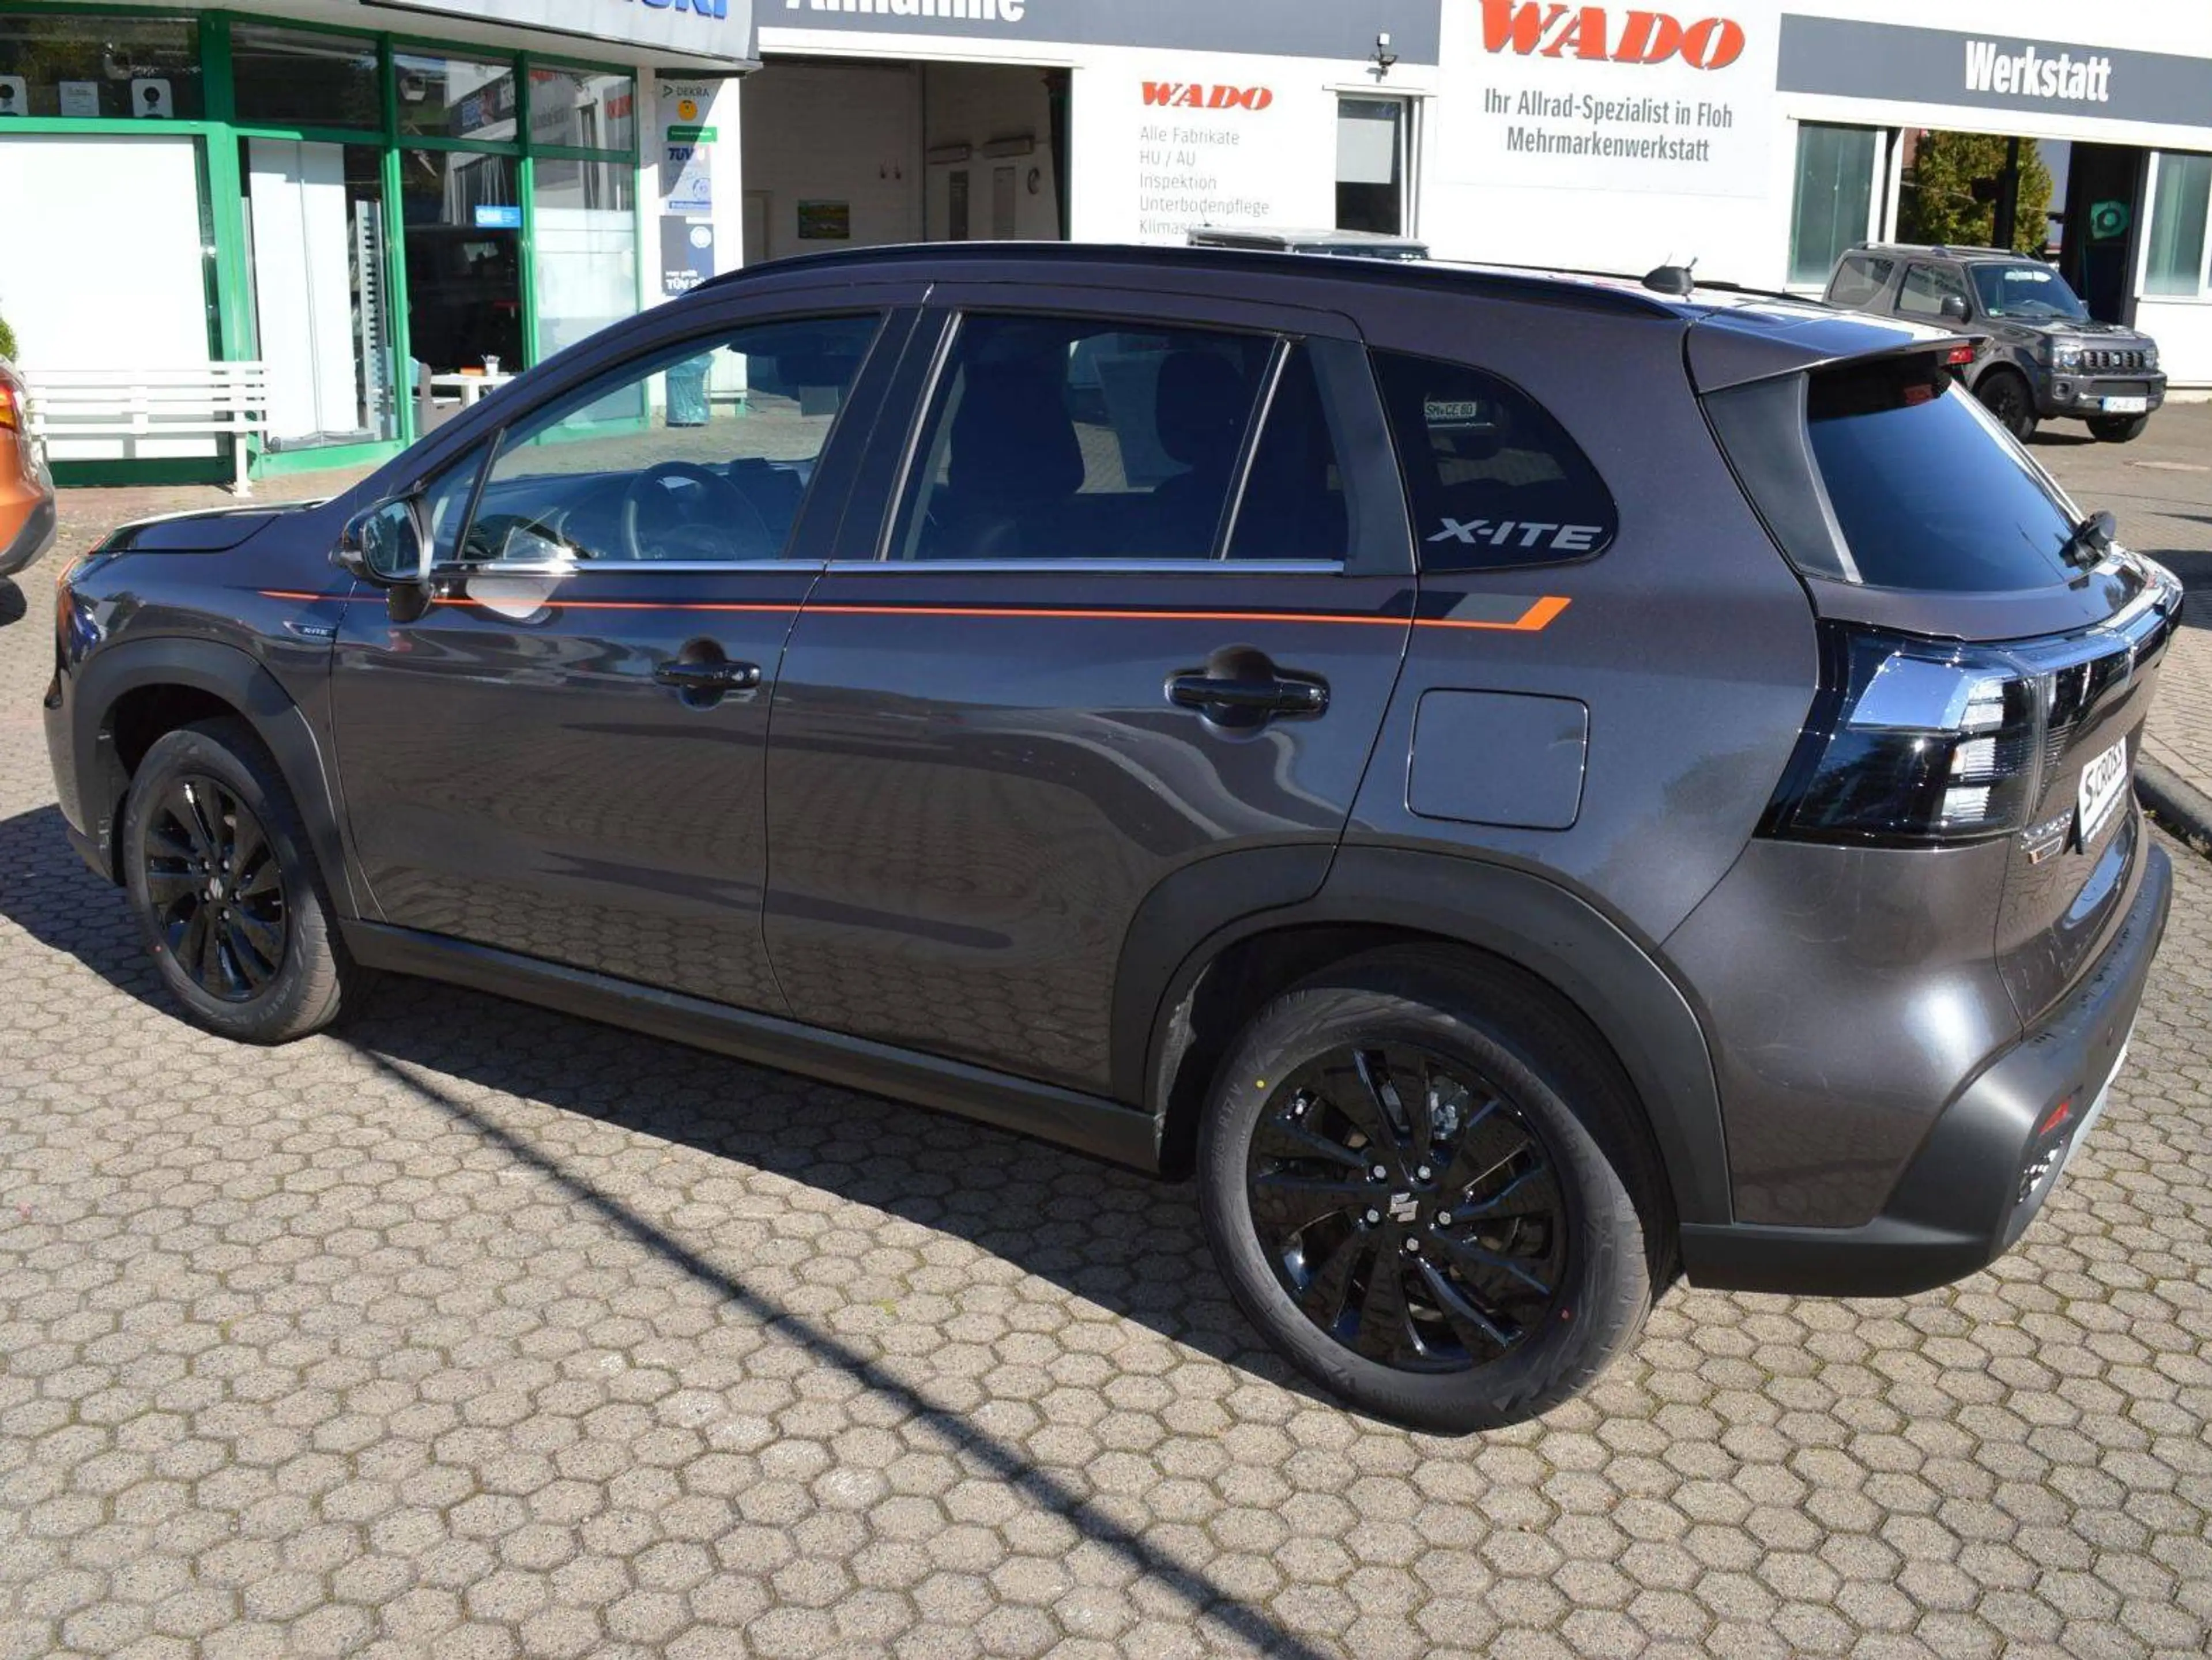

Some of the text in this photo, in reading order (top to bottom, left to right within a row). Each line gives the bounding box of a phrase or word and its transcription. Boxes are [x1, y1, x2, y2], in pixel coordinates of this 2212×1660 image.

[1479, 0, 1746, 71] WADO
[1965, 40, 2112, 103] Werkstatt
[1141, 81, 1273, 111] WADO
[1484, 87, 1733, 128] Ihr Allrad-Spezialist in Floh
[1140, 124, 1240, 145] Alle Fabrikate
[1506, 126, 1710, 162] Mehrmarkenwerkstatt
[1139, 150, 1160, 165] HU
[1177, 149, 1196, 166] AU
[1140, 172, 1217, 191] Inspektion
[1139, 195, 1270, 217] Unterbodenpflege
[1425, 518, 1603, 550] X-ITE
